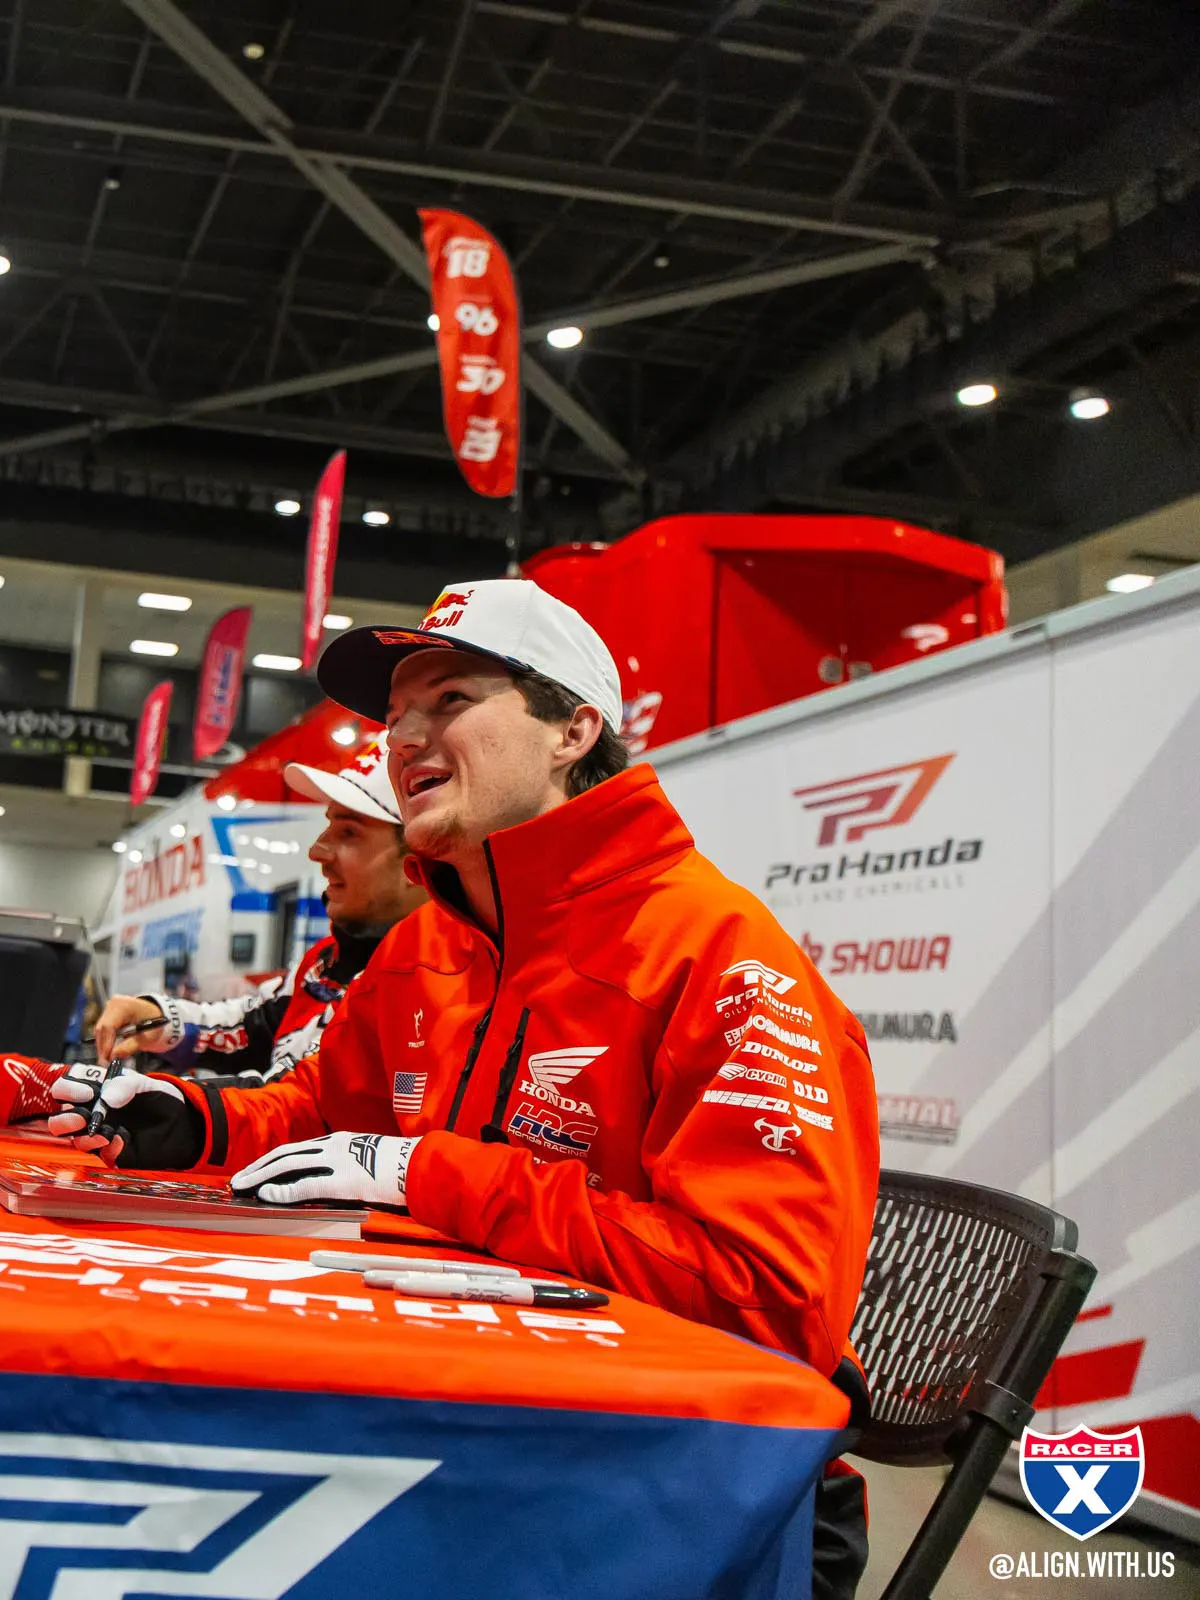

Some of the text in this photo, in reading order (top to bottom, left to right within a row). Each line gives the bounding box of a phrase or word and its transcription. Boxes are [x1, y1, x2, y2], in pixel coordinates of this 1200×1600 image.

[455, 302, 498, 336] 96
[829, 934, 952, 974] SHOWA
[724, 1005, 747, 1019] OILS
[741, 1041, 818, 1074] DUNLOP
[747, 1070, 786, 1087] CYCRA
[518, 1080, 596, 1117] HONDA
[507, 1127, 588, 1158] Honda RACING
[509, 1102, 598, 1152] HRC
